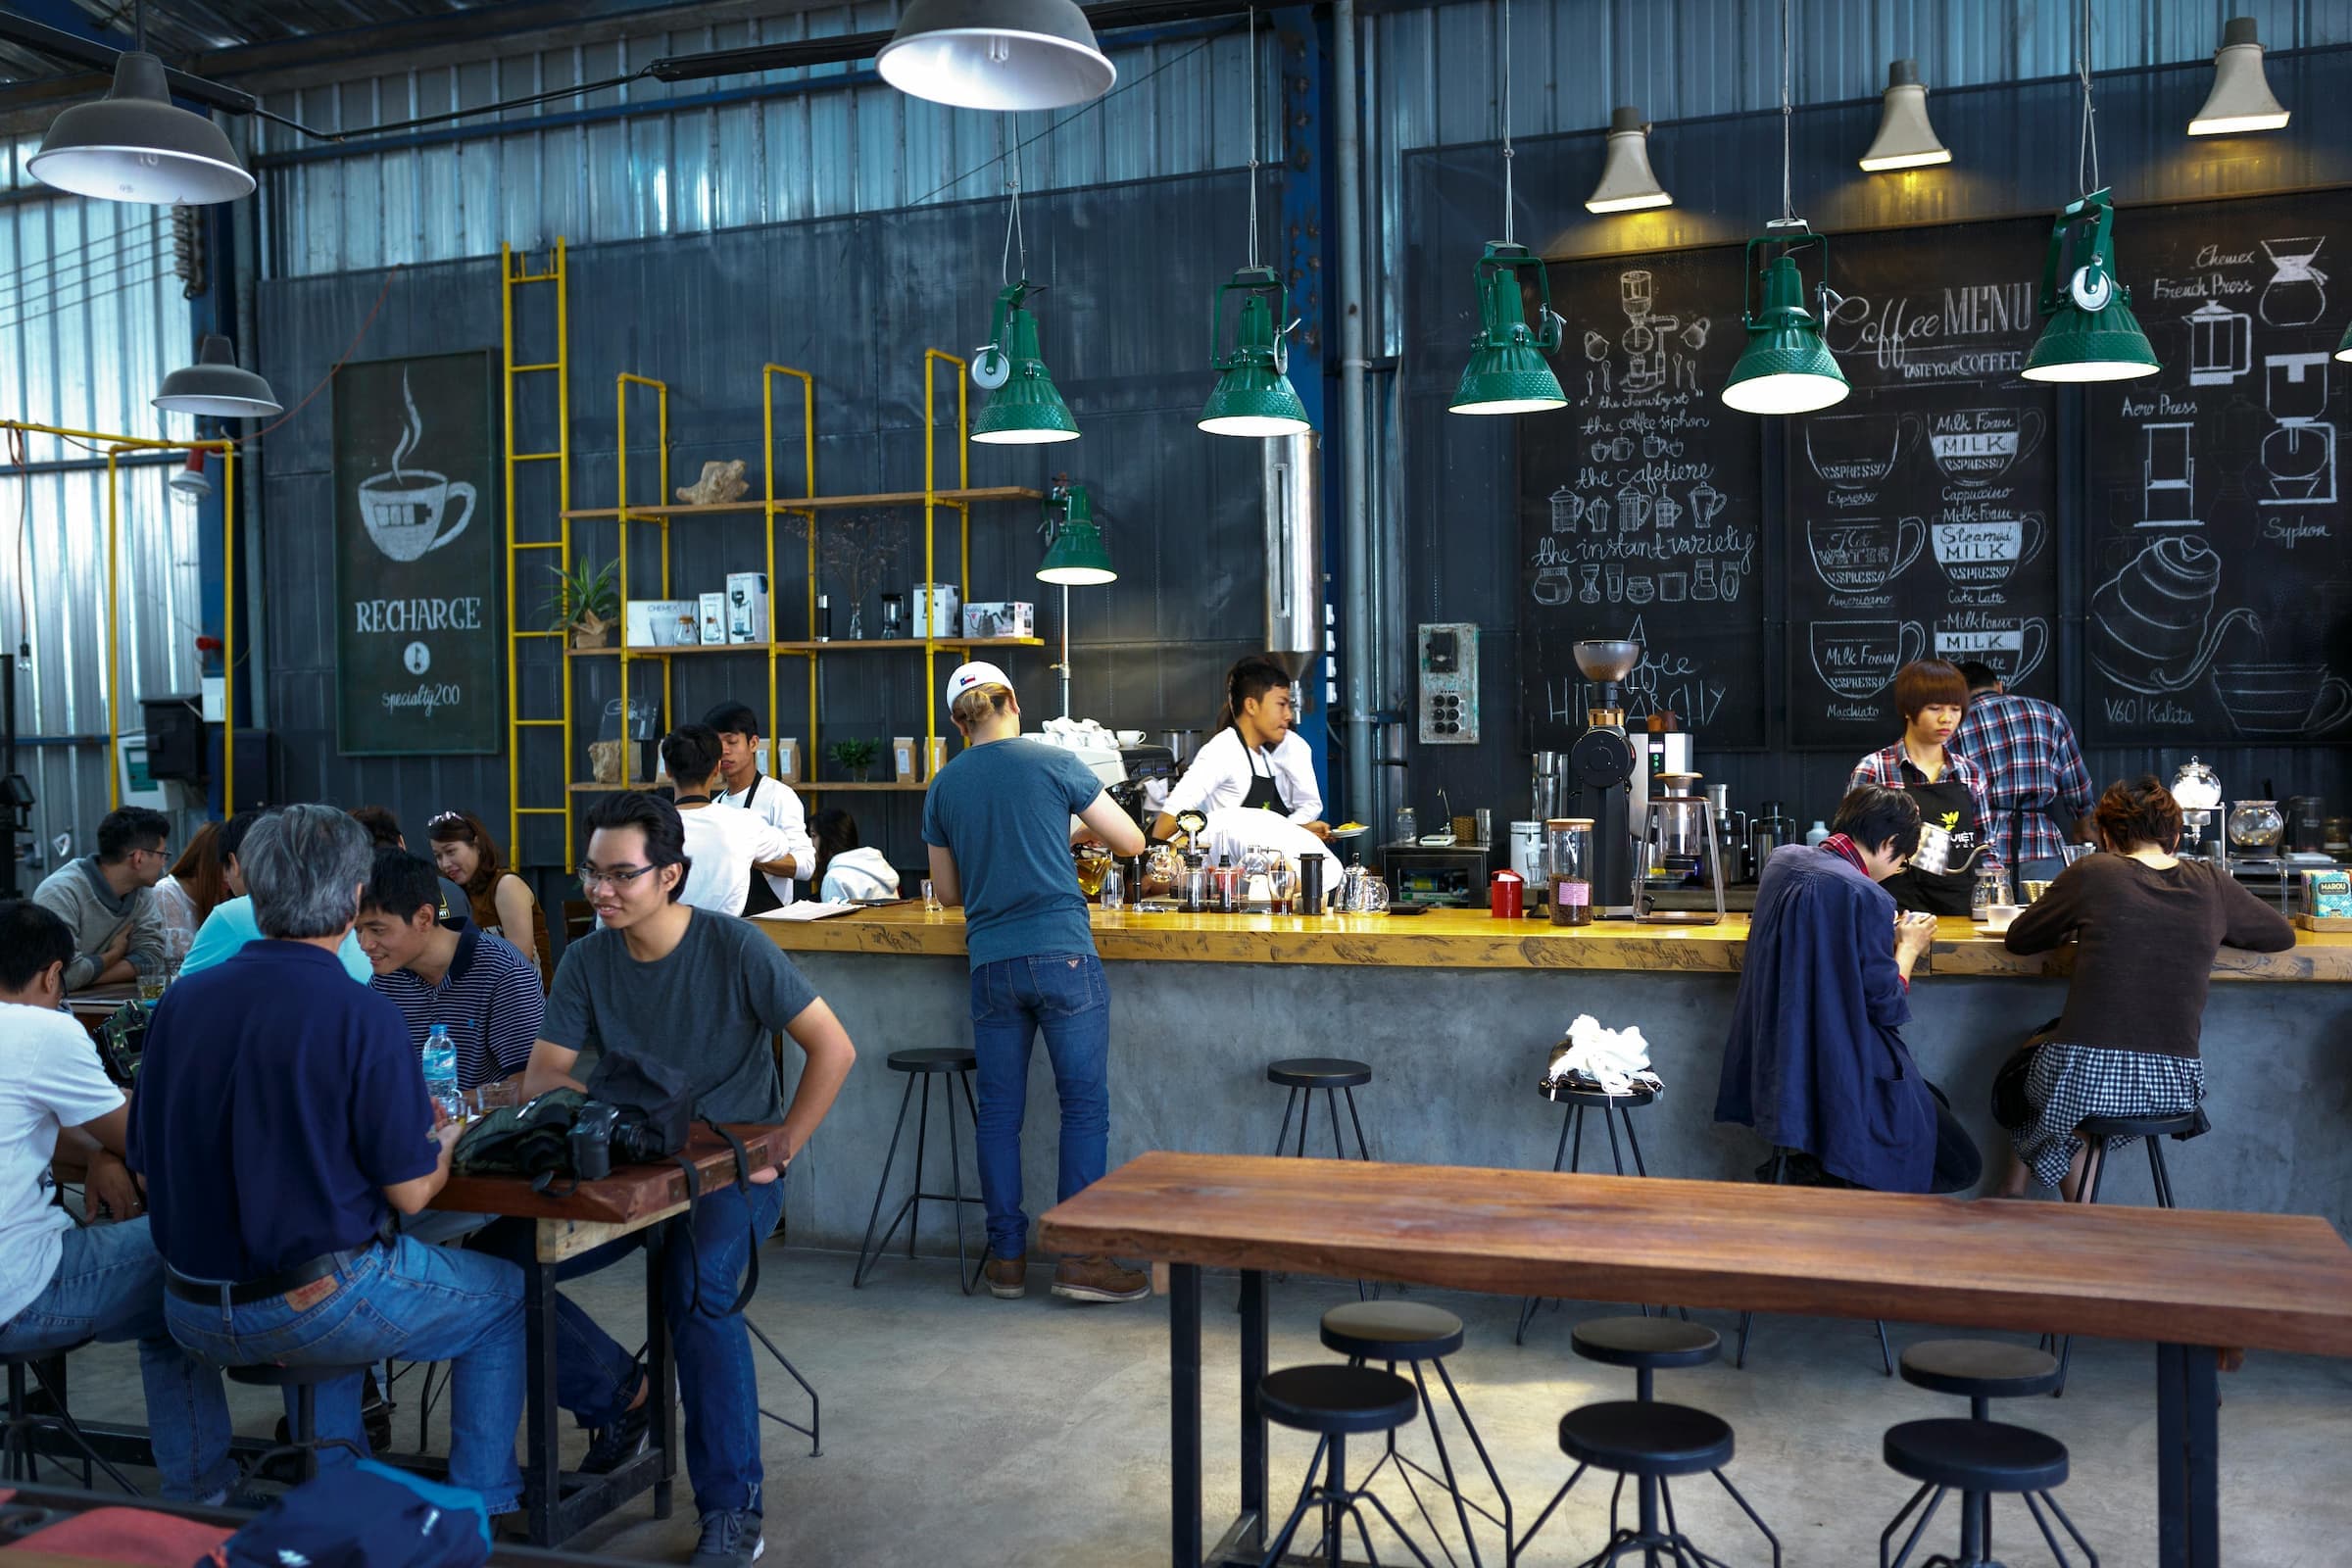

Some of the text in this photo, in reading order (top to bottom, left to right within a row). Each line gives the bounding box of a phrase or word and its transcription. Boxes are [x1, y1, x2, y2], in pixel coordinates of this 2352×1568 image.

[2196, 244, 2255, 268] Chemex
[2154, 273, 2254, 299] French Press
[1826, 281, 2034, 370] Coffee MENU
[1904, 351, 2023, 378] TASTE YOUR COFFEE
[1598, 395, 1620, 409] the
[2122, 393, 2197, 416] Aero Press
[1580, 408, 1710, 435] the coffee siphon
[1936, 412, 2014, 431] Milk Foam
[1943, 435, 2006, 453] MILK
[1575, 466, 1614, 490] the
[1943, 505, 1978, 522] Milk
[2263, 515, 2331, 549] Syphon
[1532, 525, 1755, 575] the instant variety
[1817, 547, 1889, 565] WATER
[1946, 543, 2006, 560] MILK
[1949, 566, 2010, 580] ESPRESSO
[1978, 590, 2007, 603] Latte
[355, 596, 481, 633] RECHARGE
[1947, 611, 1979, 629] Milk
[1628, 613, 1646, 648] A
[1946, 636, 2002, 649] MILK
[1825, 645, 1895, 666] Milk Foam
[2147, 700, 2194, 723] Kalita
[2321, 882, 2346, 891] MAROU
